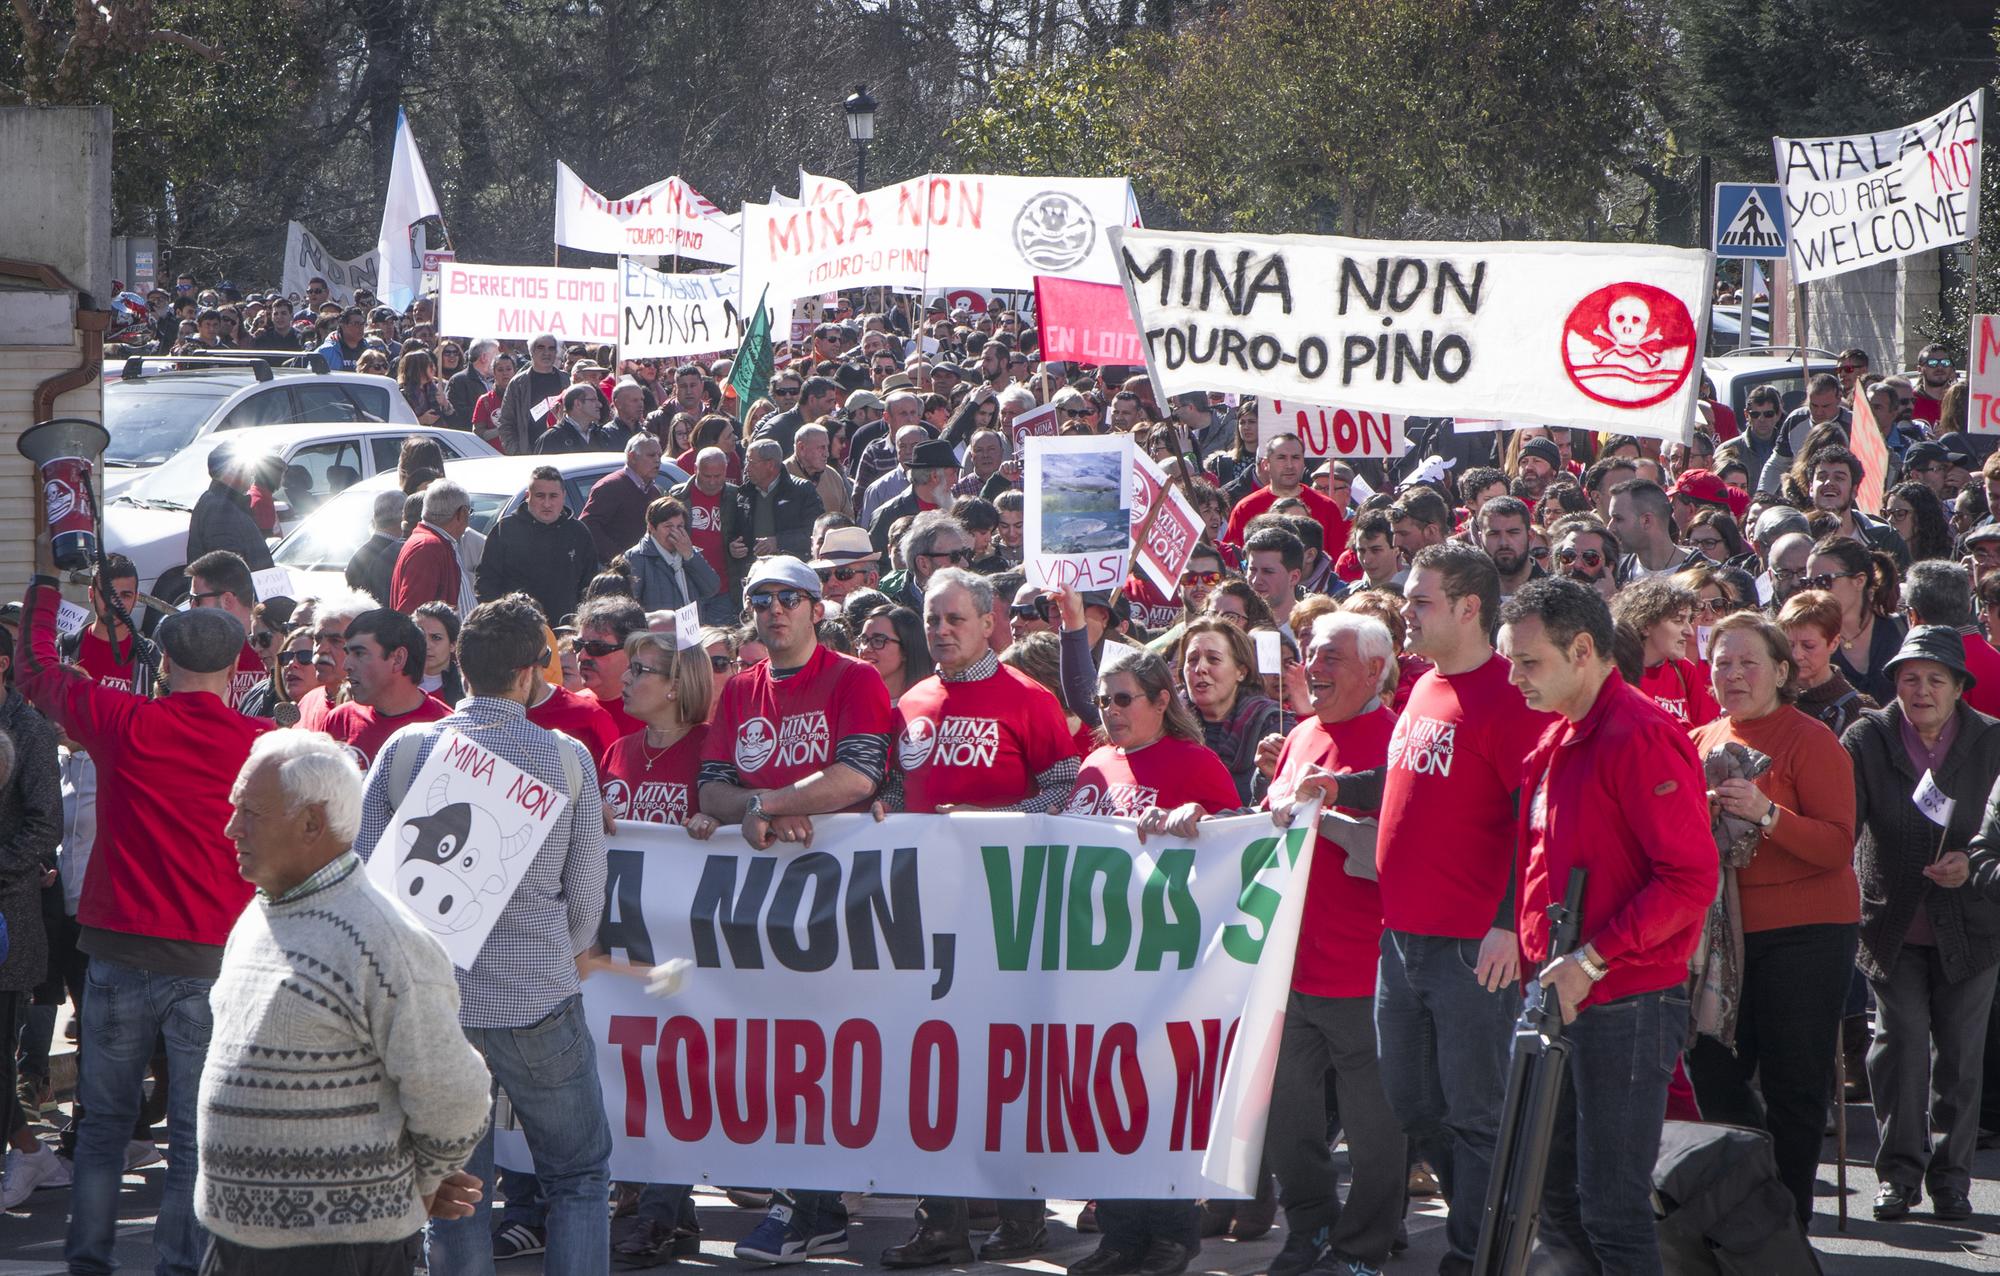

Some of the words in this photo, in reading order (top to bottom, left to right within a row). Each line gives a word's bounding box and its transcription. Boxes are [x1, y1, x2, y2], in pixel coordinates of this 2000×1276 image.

[1786, 99, 1977, 184] ATALAYA
[1786, 184, 1848, 228] YOU
[1857, 168, 1907, 213] ARE
[768, 196, 873, 263] MINA
[897, 177, 984, 230] NON
[1794, 191, 1969, 271] WELCOME
[675, 229, 704, 250] PINO
[299, 232, 379, 288] NON
[888, 248, 930, 273] PINO
[450, 270, 549, 300] BERREMOS
[556, 279, 605, 302] COMO
[1123, 246, 1293, 316] MINA
[1338, 256, 1487, 316] NON
[497, 307, 568, 336] MINA
[624, 302, 710, 346] MINA
[1046, 325, 1076, 353] EN
[1296, 408, 1393, 456] NON
[1157, 506, 1188, 550] MINA
[1036, 557, 1095, 589] VIDA
[1096, 555, 1123, 585] SI
[778, 714, 829, 740] MINA
[808, 732, 830, 741] PINO
[938, 720, 1000, 741] MINA
[938, 736, 975, 744] TOURO-O
[975, 737, 999, 747] PINO
[1409, 719, 1455, 747] MINA
[774, 739, 830, 768] NON
[932, 743, 999, 768] NON
[1400, 746, 1454, 778] NON
[1432, 742, 1455, 755] PINO
[443, 737, 496, 787] MINA
[505, 773, 557, 822] NON
[632, 801, 666, 810] TOURO-O
[666, 802, 689, 812] PINO
[633, 785, 688, 805] MINA
[1101, 785, 1158, 807] MINA
[690, 847, 957, 1001] NON,
[981, 844, 1201, 973] VIDA
[608, 1014, 884, 1151] TOURO
[908, 1019, 960, 1153] O
[985, 1022, 1150, 1156] PINO
